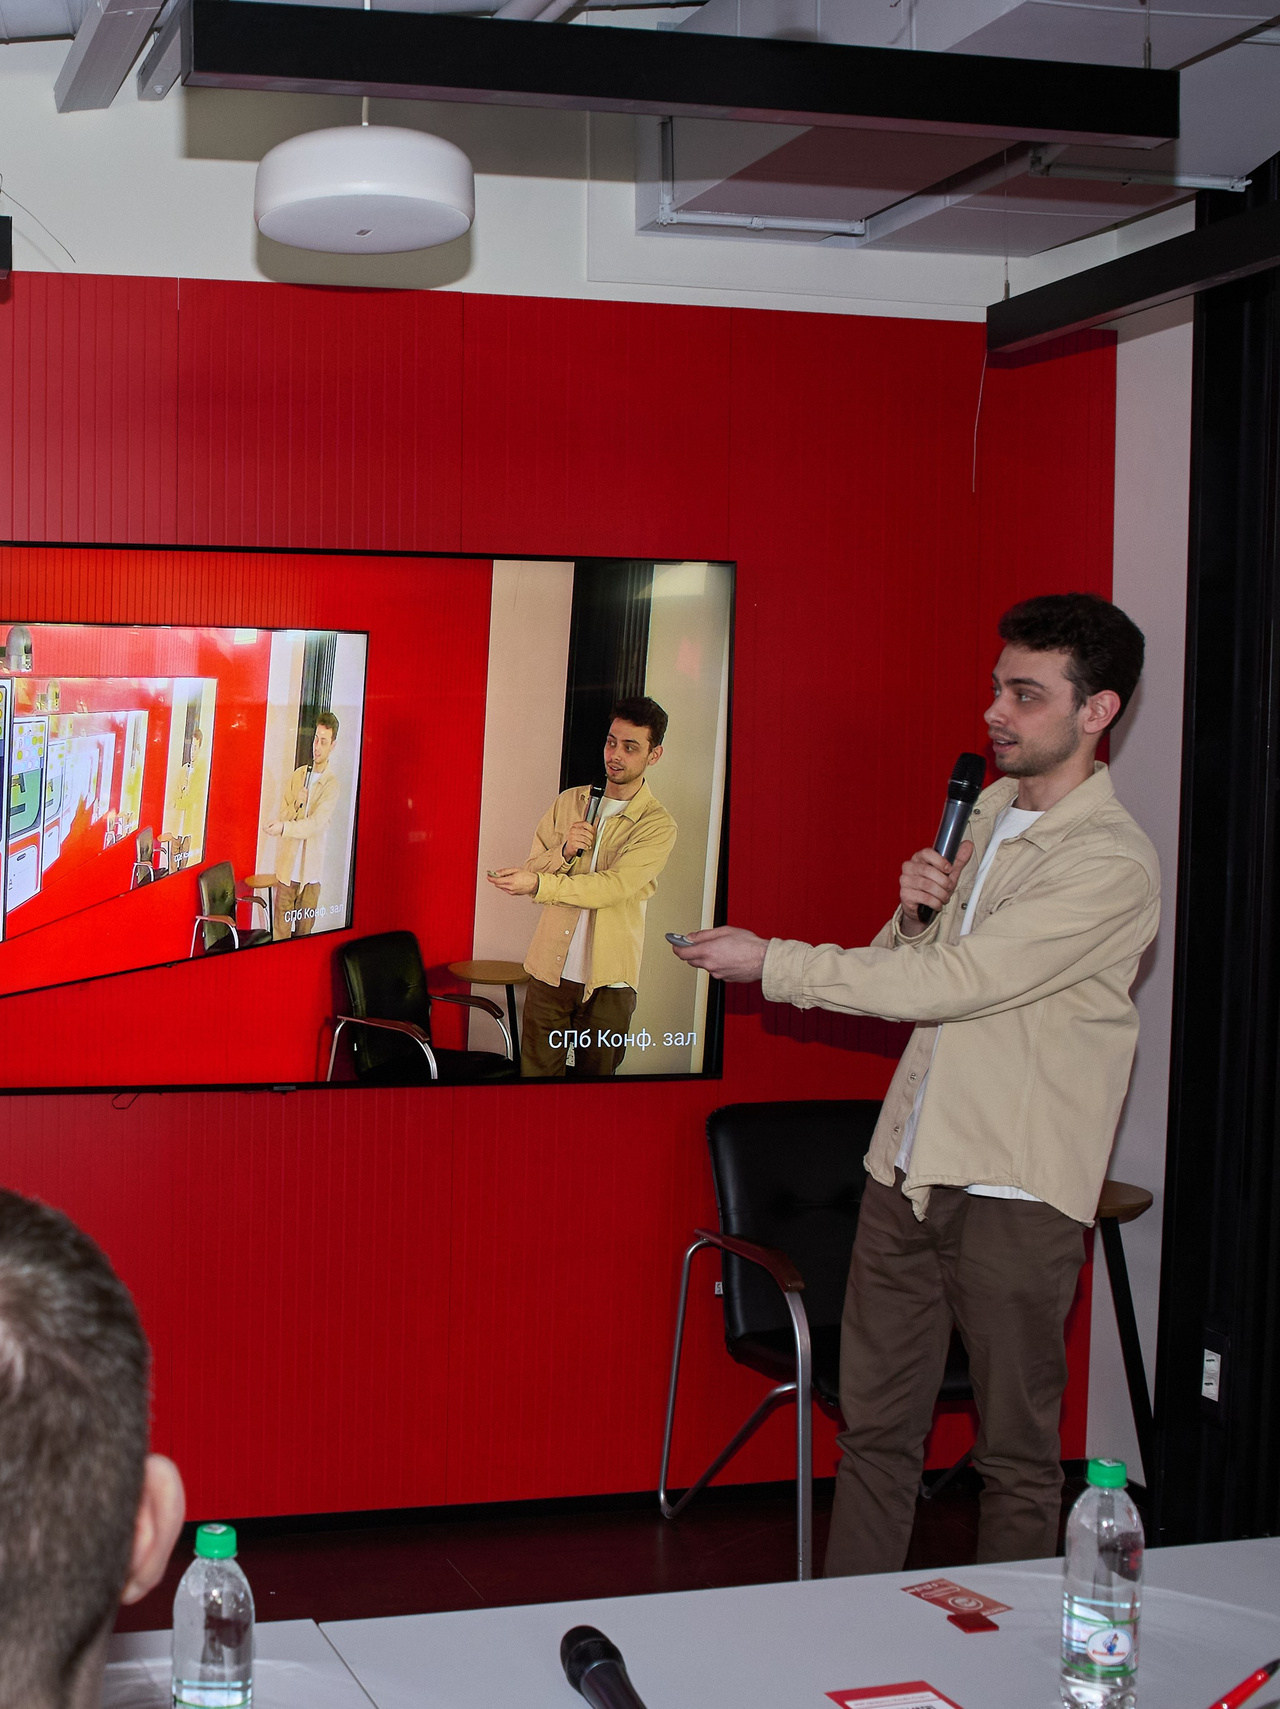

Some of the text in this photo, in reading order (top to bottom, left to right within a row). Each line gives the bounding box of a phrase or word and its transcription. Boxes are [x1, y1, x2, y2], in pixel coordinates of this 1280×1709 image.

[548, 1027, 697, 1051] СПб Конф. зал
